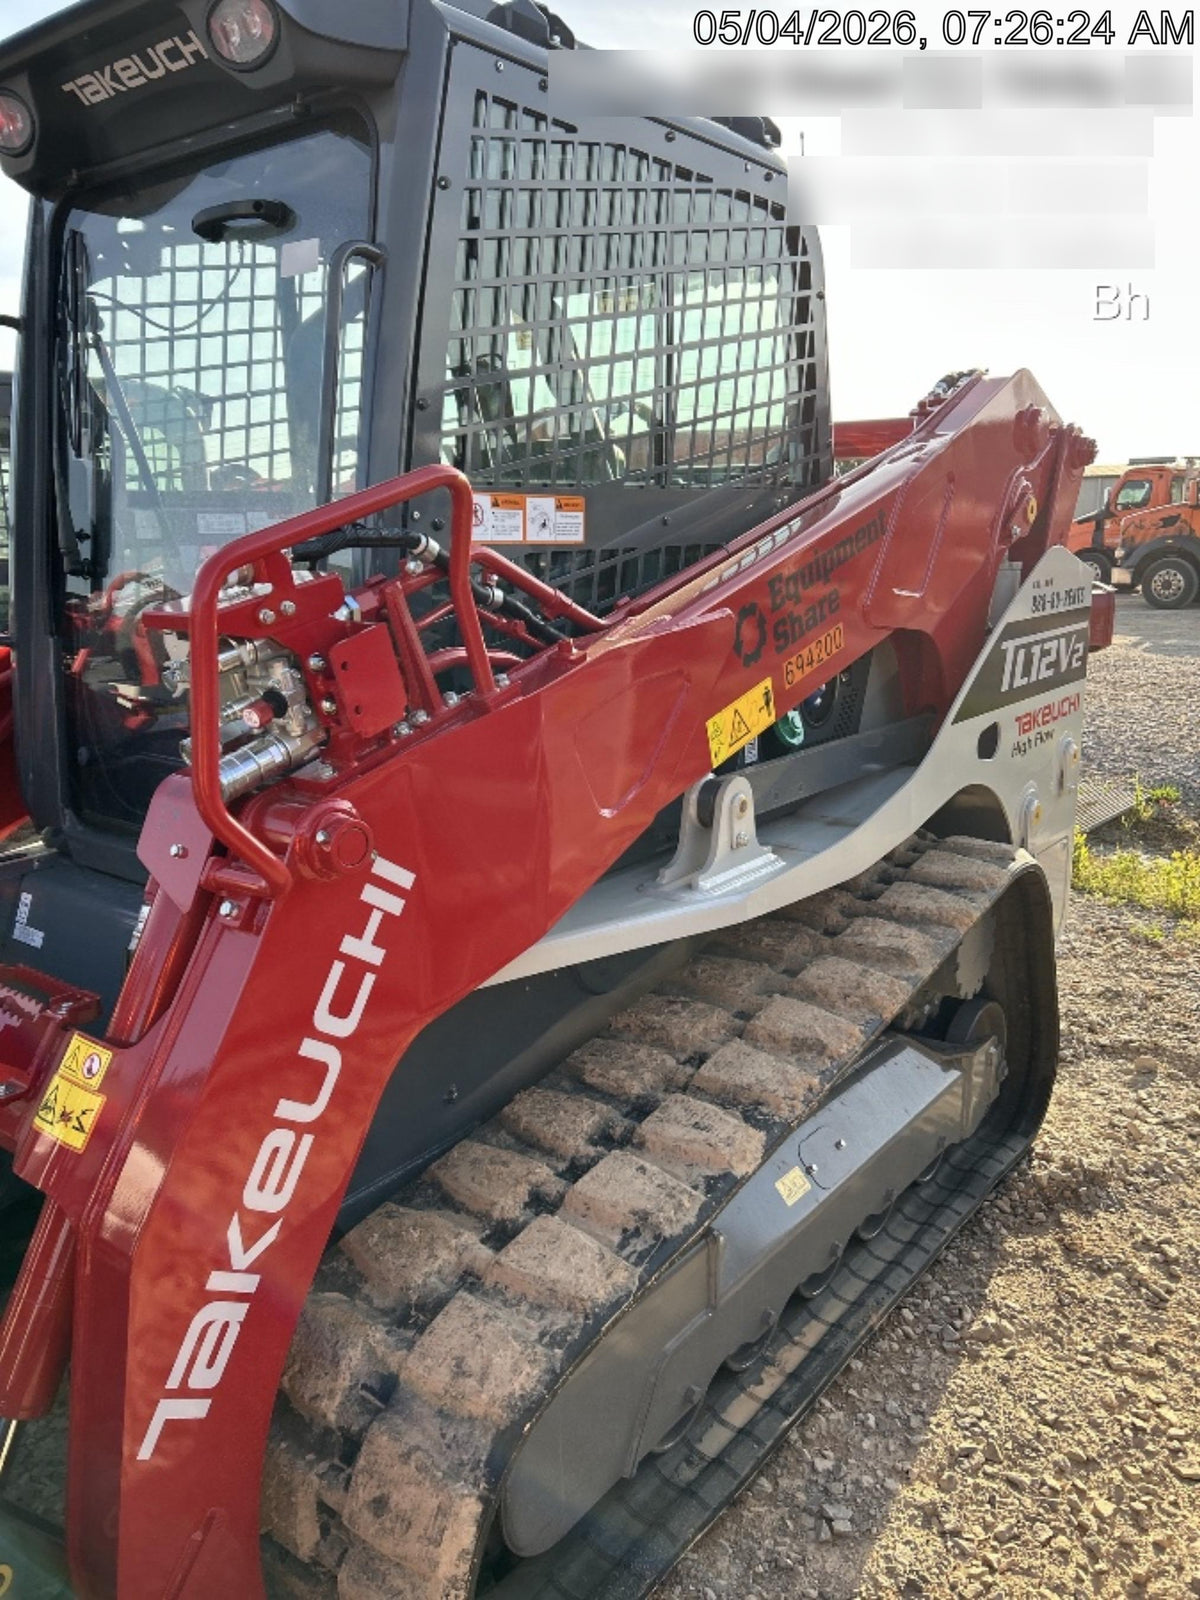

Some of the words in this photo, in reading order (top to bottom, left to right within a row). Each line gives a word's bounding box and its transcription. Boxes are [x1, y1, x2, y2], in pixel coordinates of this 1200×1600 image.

[768, 509, 887, 613] Equipment
[773, 587, 841, 655] Share
[784, 626, 842, 686] 694200
[1001, 622, 1088, 692] TL12V2
